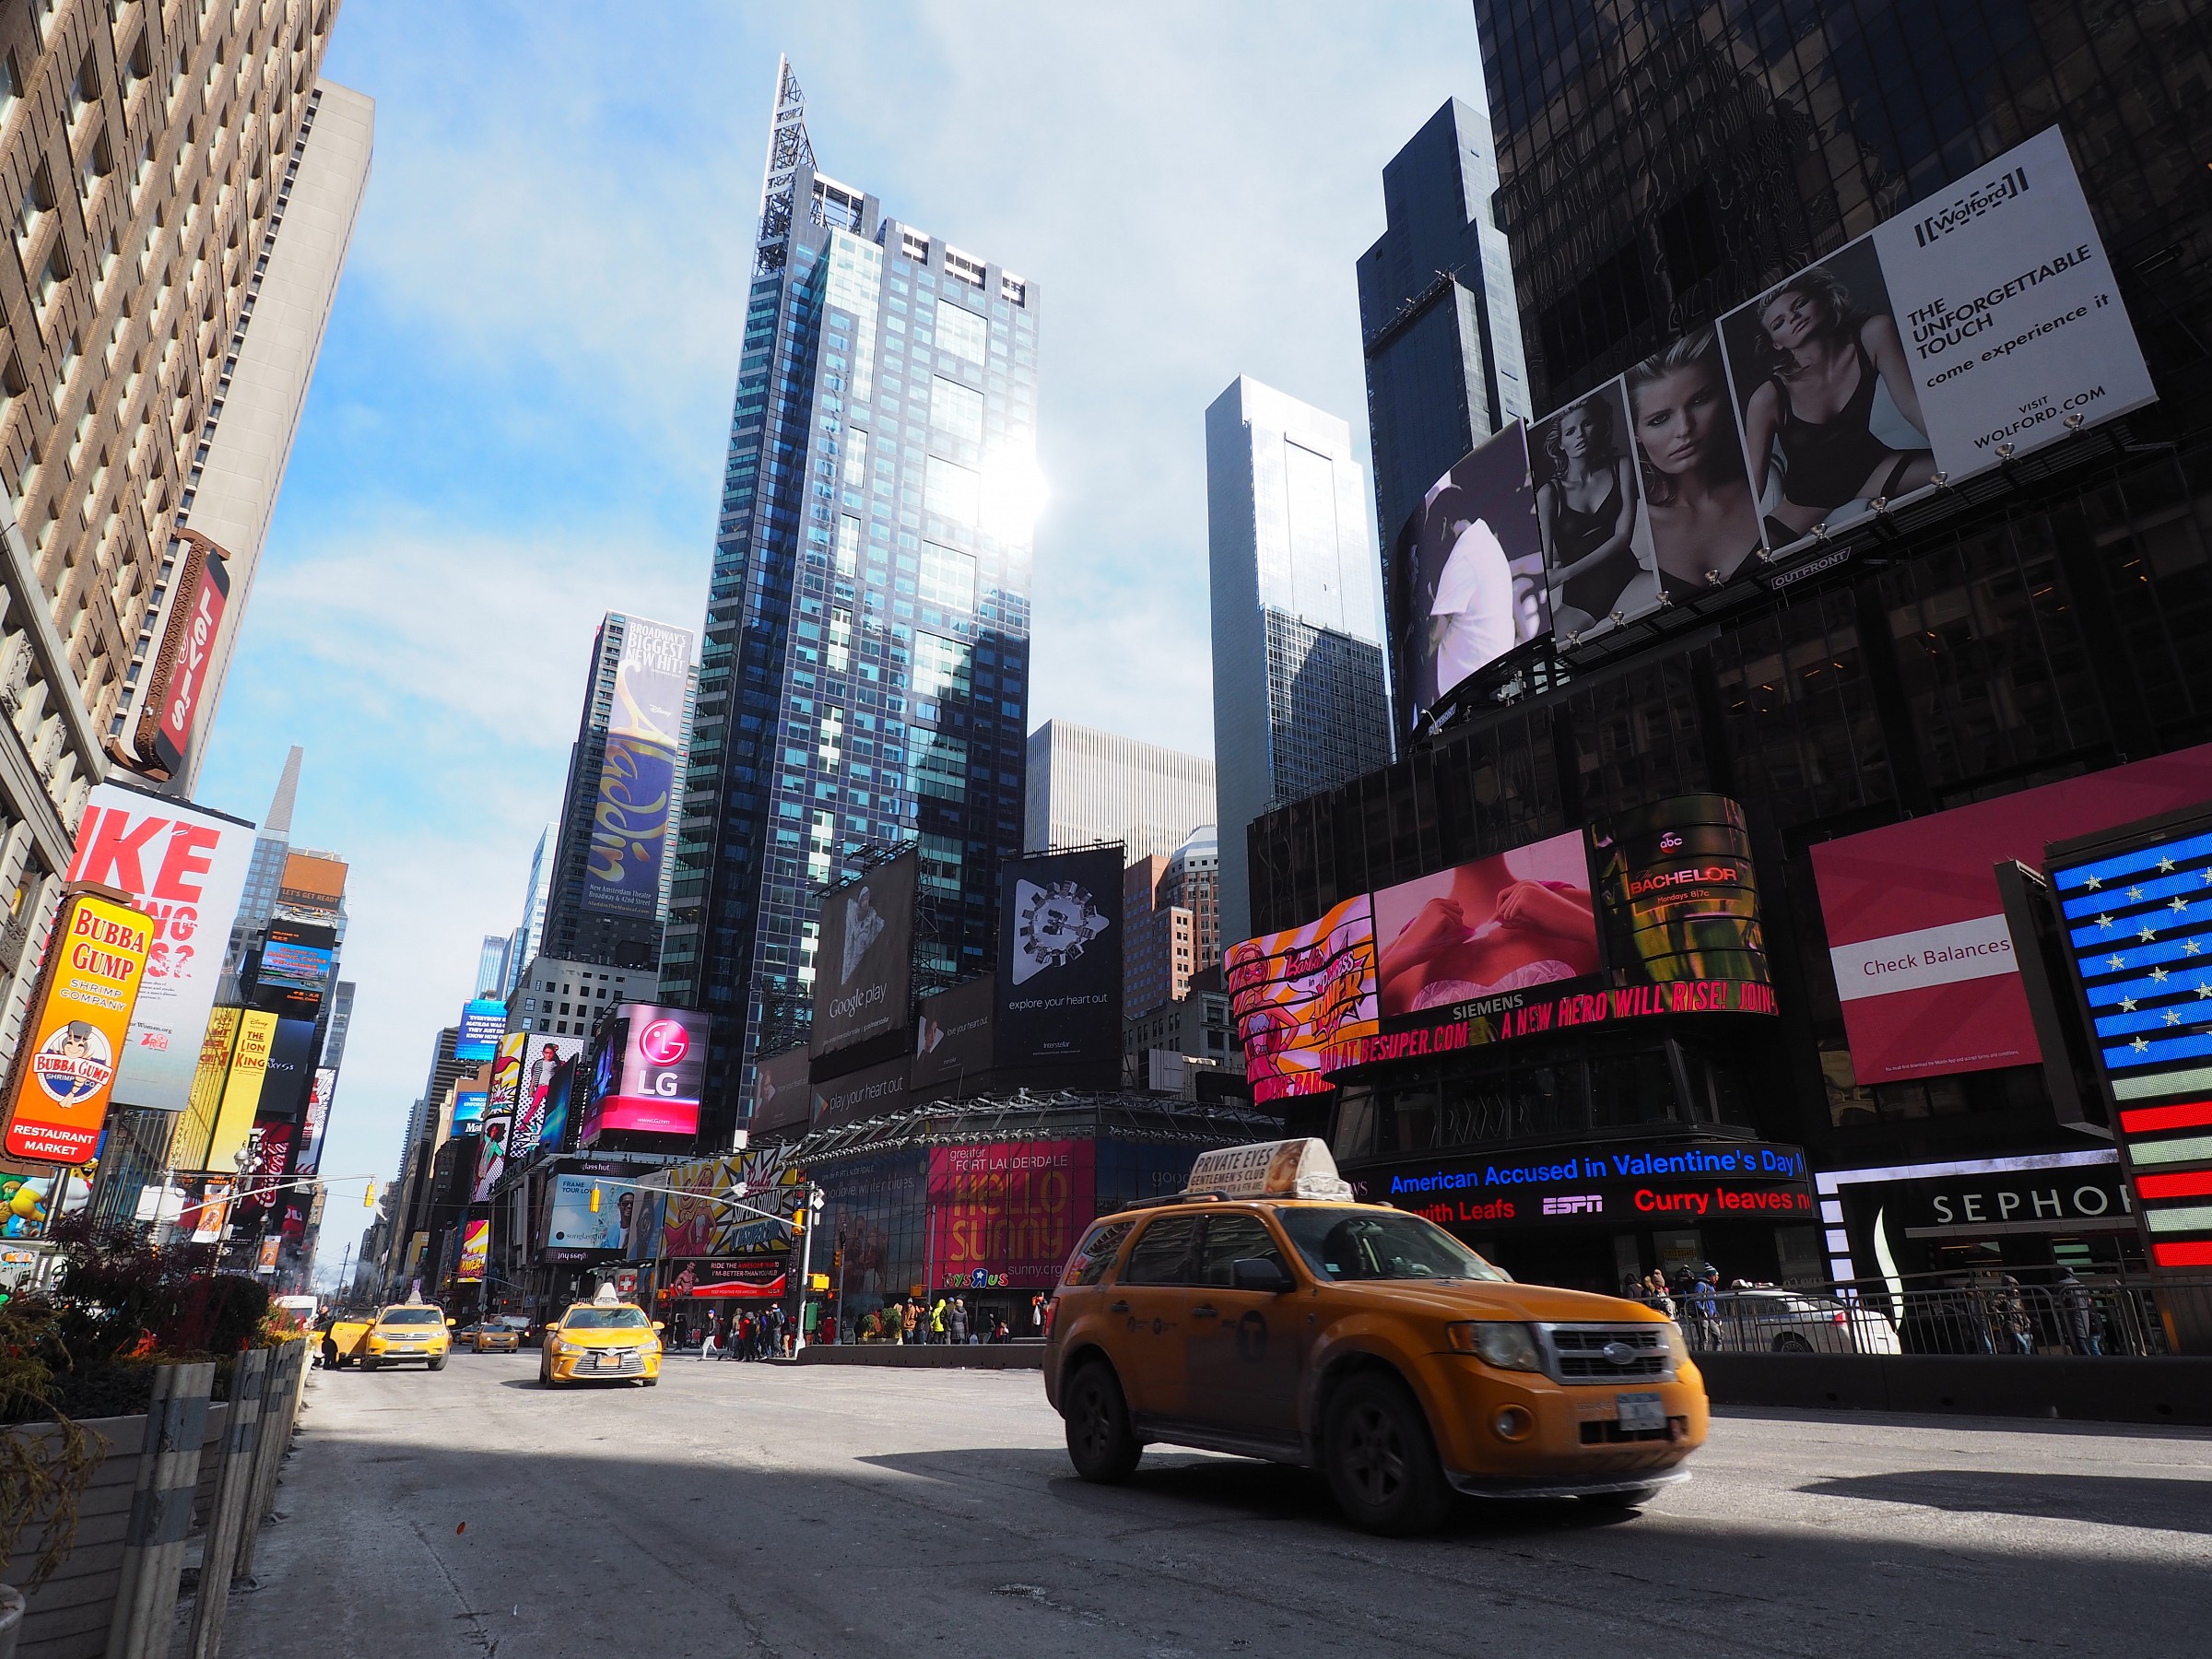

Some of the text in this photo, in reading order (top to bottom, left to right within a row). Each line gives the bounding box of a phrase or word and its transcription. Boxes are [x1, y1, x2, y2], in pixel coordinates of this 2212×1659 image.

[1932, 183, 2008, 231] Wolford
[1912, 244, 2092, 344] UNFORGETTABLE
[1907, 298, 1947, 327] THE
[1916, 312, 1994, 360] TOUCH
[1926, 292, 2110, 388] come experience it
[2018, 395, 2049, 414] VISIT
[1973, 385, 2106, 450] WOLFORD.COM
[1775, 550, 1846, 586] OUTFRONT
[626, 647, 655, 666] NEW
[628, 632, 686, 659] BIGGEST
[1660, 836, 1684, 848] abc
[1630, 865, 1737, 895] BACHELOR
[282, 888, 300, 897] LET'S
[317, 895, 339, 903] READY
[589, 891, 614, 901] Broadway
[602, 886, 631, 897] Amsterdam
[632, 890, 652, 900] Theatre
[1657, 891, 1689, 904] Mondays
[74, 908, 145, 953] BUBBA
[72, 943, 135, 981] GUMP
[1864, 937, 2011, 976] Check Balances
[71, 979, 123, 997] SHRIMP
[1308, 978, 1315, 987] in
[60, 989, 126, 1011] COMPANY
[830, 982, 888, 1018] Google play
[1009, 994, 1108, 1011] explore your heart out
[1453, 994, 1524, 1020] SIEMENS
[1360, 1021, 1469, 1065] BESUPER.COM
[1500, 1013, 1512, 1040] A
[1516, 1002, 1553, 1036] NEW
[1558, 991, 1607, 1027] HERO
[1615, 984, 1665, 1018] WILL
[1672, 980, 1728, 1011] RISE!
[1738, 982, 1771, 1013] JOIN
[247, 1030, 265, 1041] THE
[46, 1073, 76, 1081] SHRIMP
[638, 1070, 678, 1097] LG
[830, 1076, 904, 1114] play your heart out
[14, 1124, 95, 1145] RESTAURANT
[25, 1140, 78, 1156] MARKET
[949, 1147, 986, 1161] greater
[956, 1155, 1068, 1171] FORT LAUDERDALE
[1194, 1147, 1273, 1173] PRIVATE EYES
[1190, 1168, 1265, 1186] GENTLEMEN'S CLUB
[1391, 1171, 1478, 1194] American
[1485, 1158, 1579, 1186] Accused
[1584, 1158, 1607, 1178] in
[1613, 1149, 1758, 1176] Valentine's
[1761, 1149, 1794, 1177] Day
[858, 1178, 886, 1194] winter
[1459, 1198, 1516, 1221] Leafs
[1543, 1194, 1603, 1215] ESPN
[1634, 1187, 1794, 1215] Curry leaves
[1008, 1265, 1063, 1278] sunny.org
